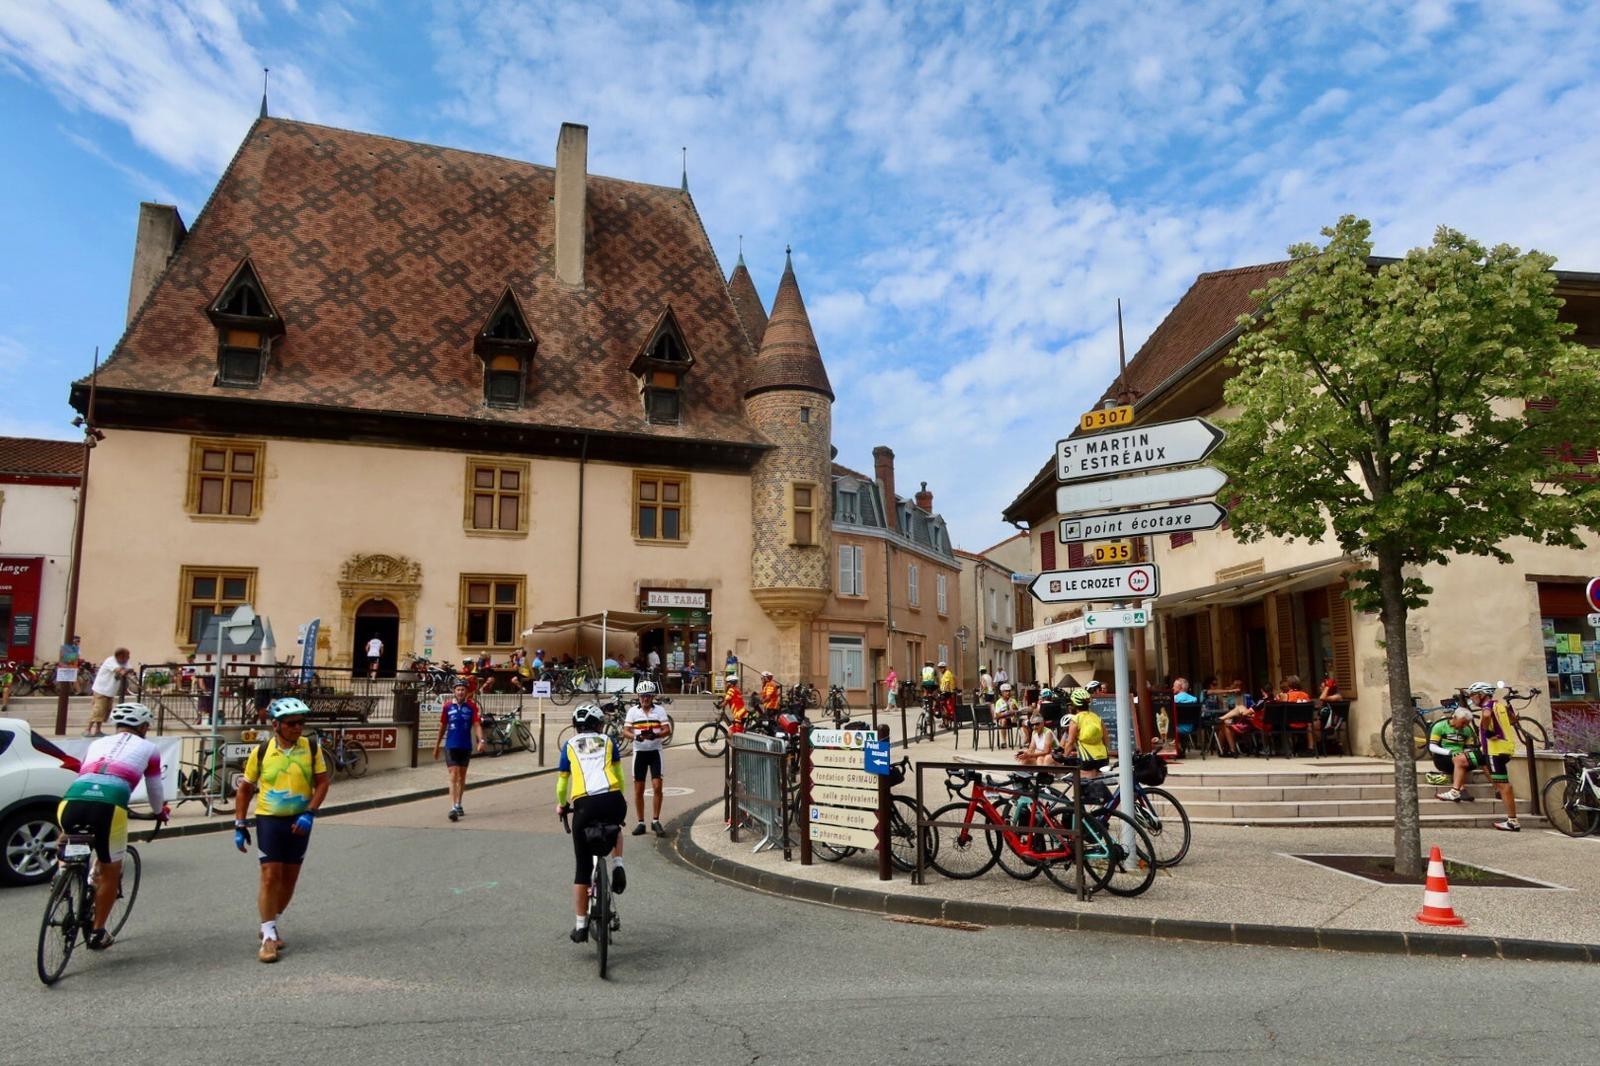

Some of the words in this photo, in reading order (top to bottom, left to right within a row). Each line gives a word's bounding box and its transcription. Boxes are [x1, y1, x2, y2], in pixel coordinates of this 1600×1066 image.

[1085, 415, 1093, 427] D
[1098, 409, 1127, 425] 307
[1086, 433, 1149, 454] MARTIN
[1081, 447, 1165, 471] ESTRÉAUX
[1084, 520, 1123, 538] point
[1131, 513, 1192, 530] écotaxe
[1096, 548, 1104, 560] D
[1110, 545, 1128, 559] 35
[1065, 580, 1077, 591] LE
[1080, 577, 1121, 590] CROZET
[651, 594, 669, 604] BAR
[674, 595, 704, 605] TABAC
[816, 731, 842, 743] boucle
[866, 742, 880, 750] Point
[849, 755, 856, 764] de
[816, 772, 844, 781] fondation
[847, 774, 878, 785] GRIMAUD
[822, 791, 837, 799] salle
[840, 793, 878, 804] polyvalente
[820, 812, 839, 821] mairie
[819, 830, 851, 841] pharmacie
